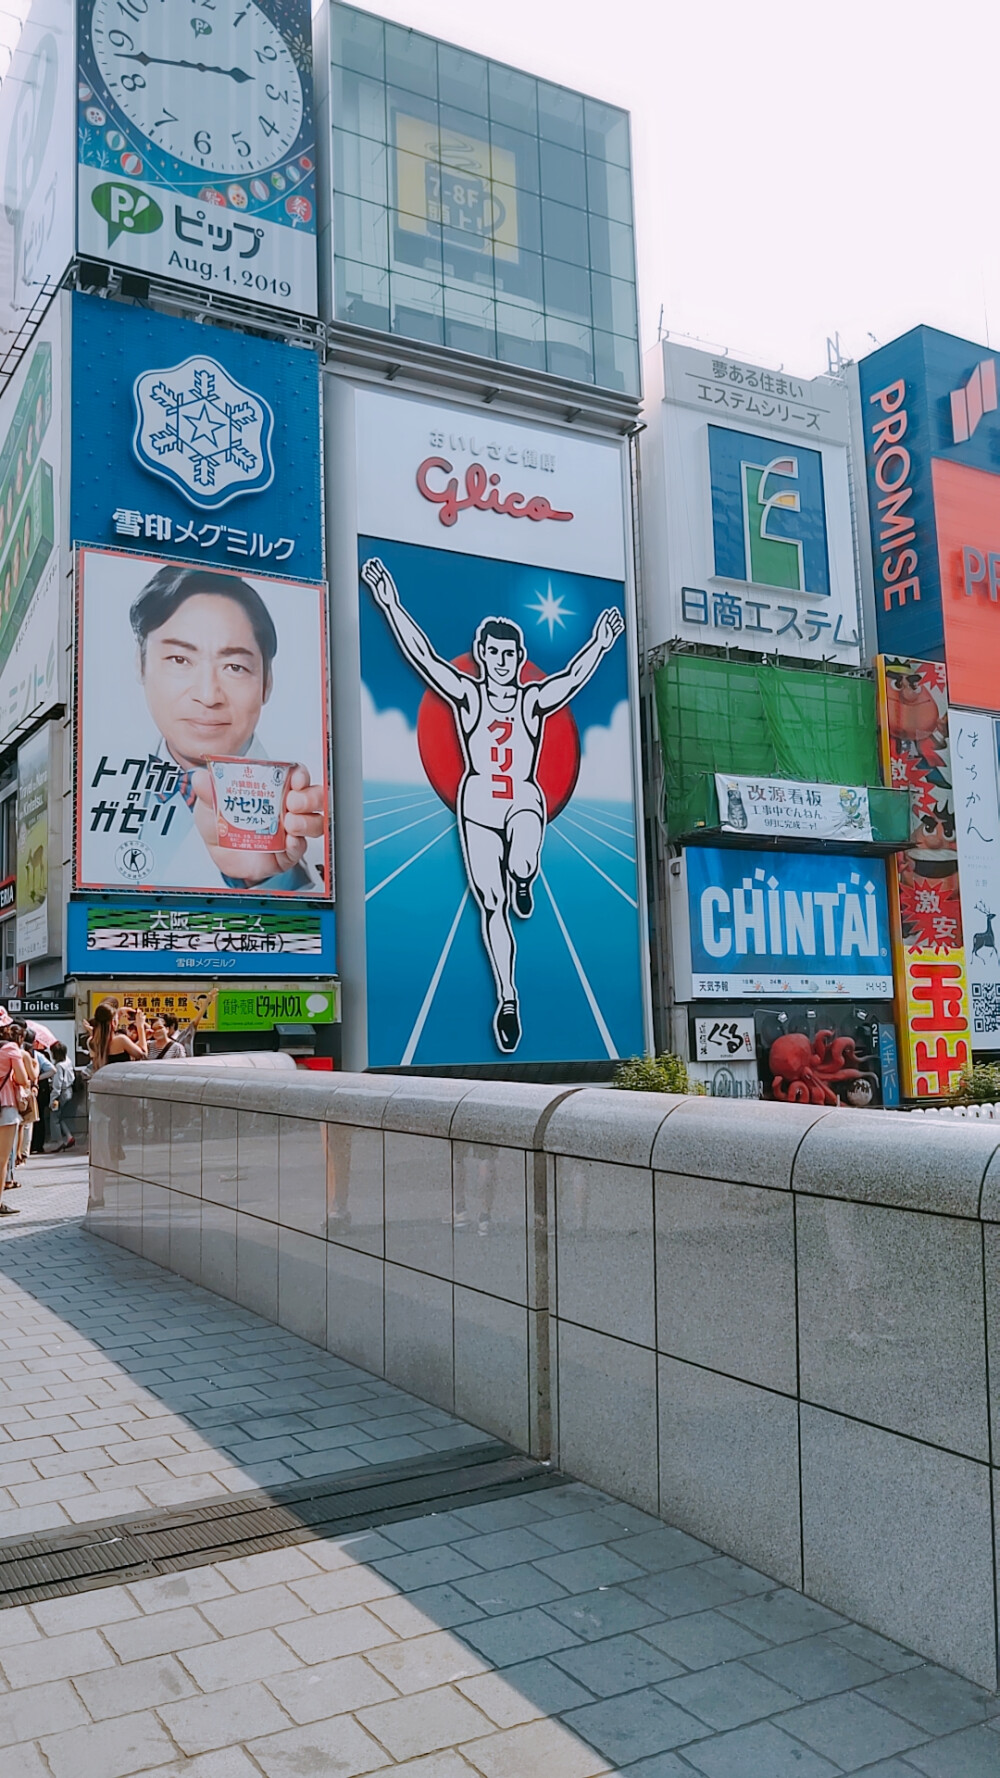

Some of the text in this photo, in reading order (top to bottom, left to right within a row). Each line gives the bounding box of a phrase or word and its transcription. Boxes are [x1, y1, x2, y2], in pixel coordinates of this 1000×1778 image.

[117, 0, 149, 22] 10
[233, 11, 247, 28] 1
[108, 29, 134, 51] 9
[253, 45, 278, 64] 2
[120, 73, 147, 92] 8
[265, 84, 289, 105] 3
[154, 107, 180, 127] 7
[258, 115, 281, 138] 4
[193, 130, 213, 155] 6
[231, 131, 252, 158] 5
[428, 176, 480, 210] 7-8F
[174, 204, 265, 259] ピップ
[711, 359, 804, 398] 夢ある住まい
[698, 384, 821, 431] エステムシリーズ
[429, 430, 555, 473] おいしさと健康
[416, 456, 574, 527] Glico
[870, 379, 921, 611] PROMISE
[112, 507, 295, 561] 雪印メグミルク
[681, 586, 860, 647] 日商エステム
[487, 716, 516, 800] グリコ
[91, 756, 180, 793] トクホ
[127, 792, 141, 802] の
[746, 784, 823, 807] 改源看板
[90, 801, 176, 836] ガセリ
[150, 909, 265, 931] 大阪ニュース
[914, 889, 957, 939] 激安
[175, 956, 236, 968] 雪印メグミルク
[699, 980, 729, 992] 天気予報
[23, 1001, 59, 1012] Toilets
[123, 997, 188, 1008] 店舗情報館
[256, 995, 303, 1018] ピタットハウス
[707, 1023, 744, 1053] くくる
